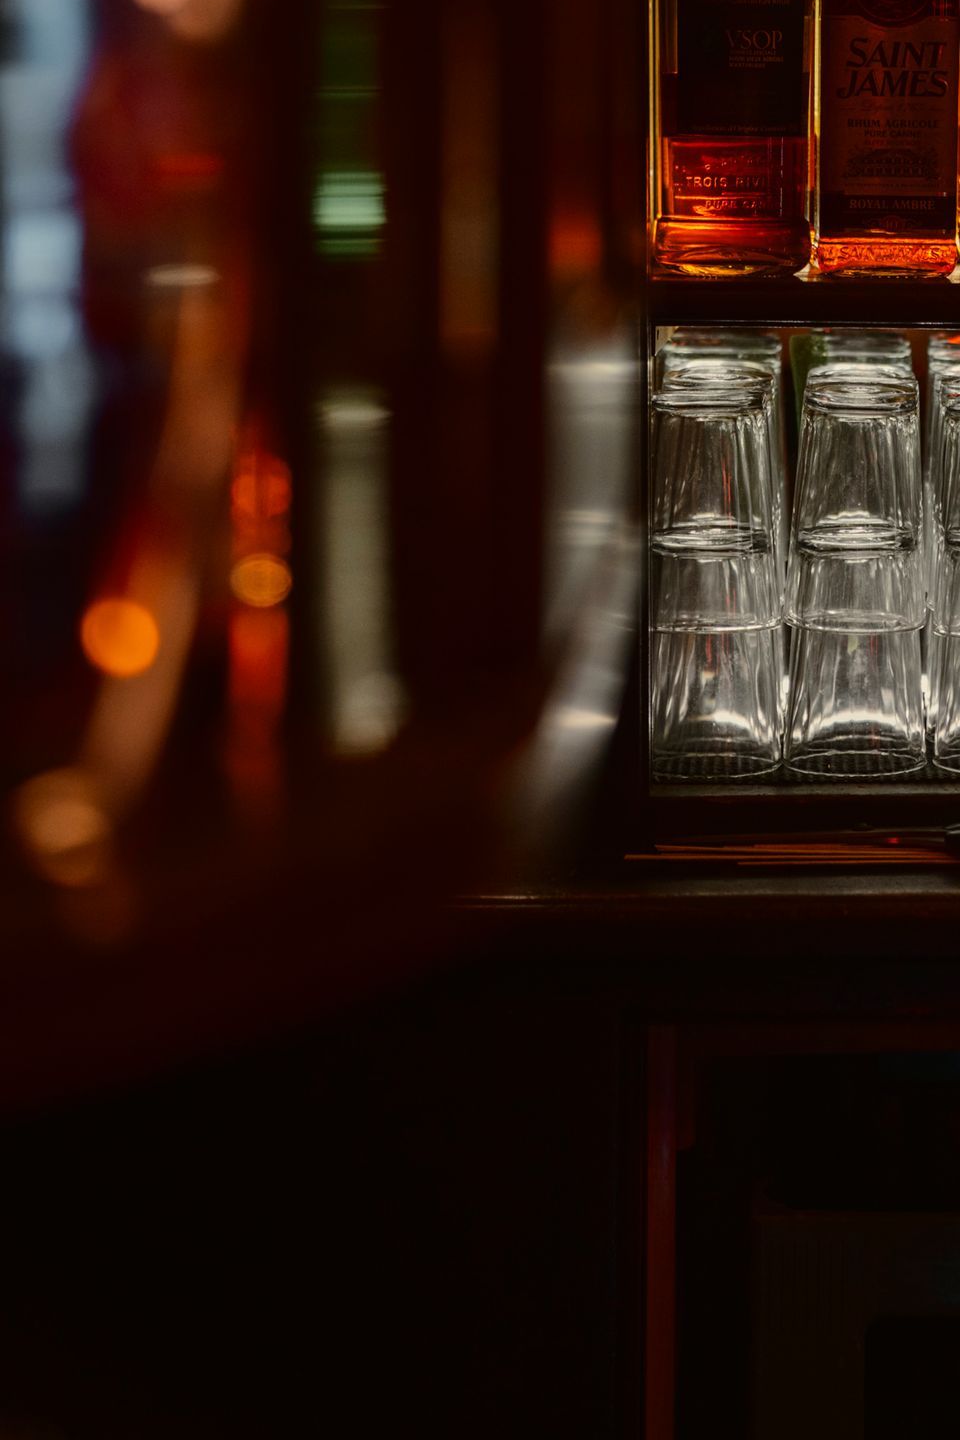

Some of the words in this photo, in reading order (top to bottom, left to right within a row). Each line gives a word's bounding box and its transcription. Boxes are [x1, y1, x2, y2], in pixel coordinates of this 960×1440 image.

[724, 28, 783, 50] VSOP
[846, 37, 947, 68] SAINT
[836, 70, 948, 98] JAMES
[848, 119, 881, 128] RHUM
[686, 176, 728, 188] TROIS
[850, 199, 888, 209] ROYAL
[891, 199, 936, 209] AMBRE
